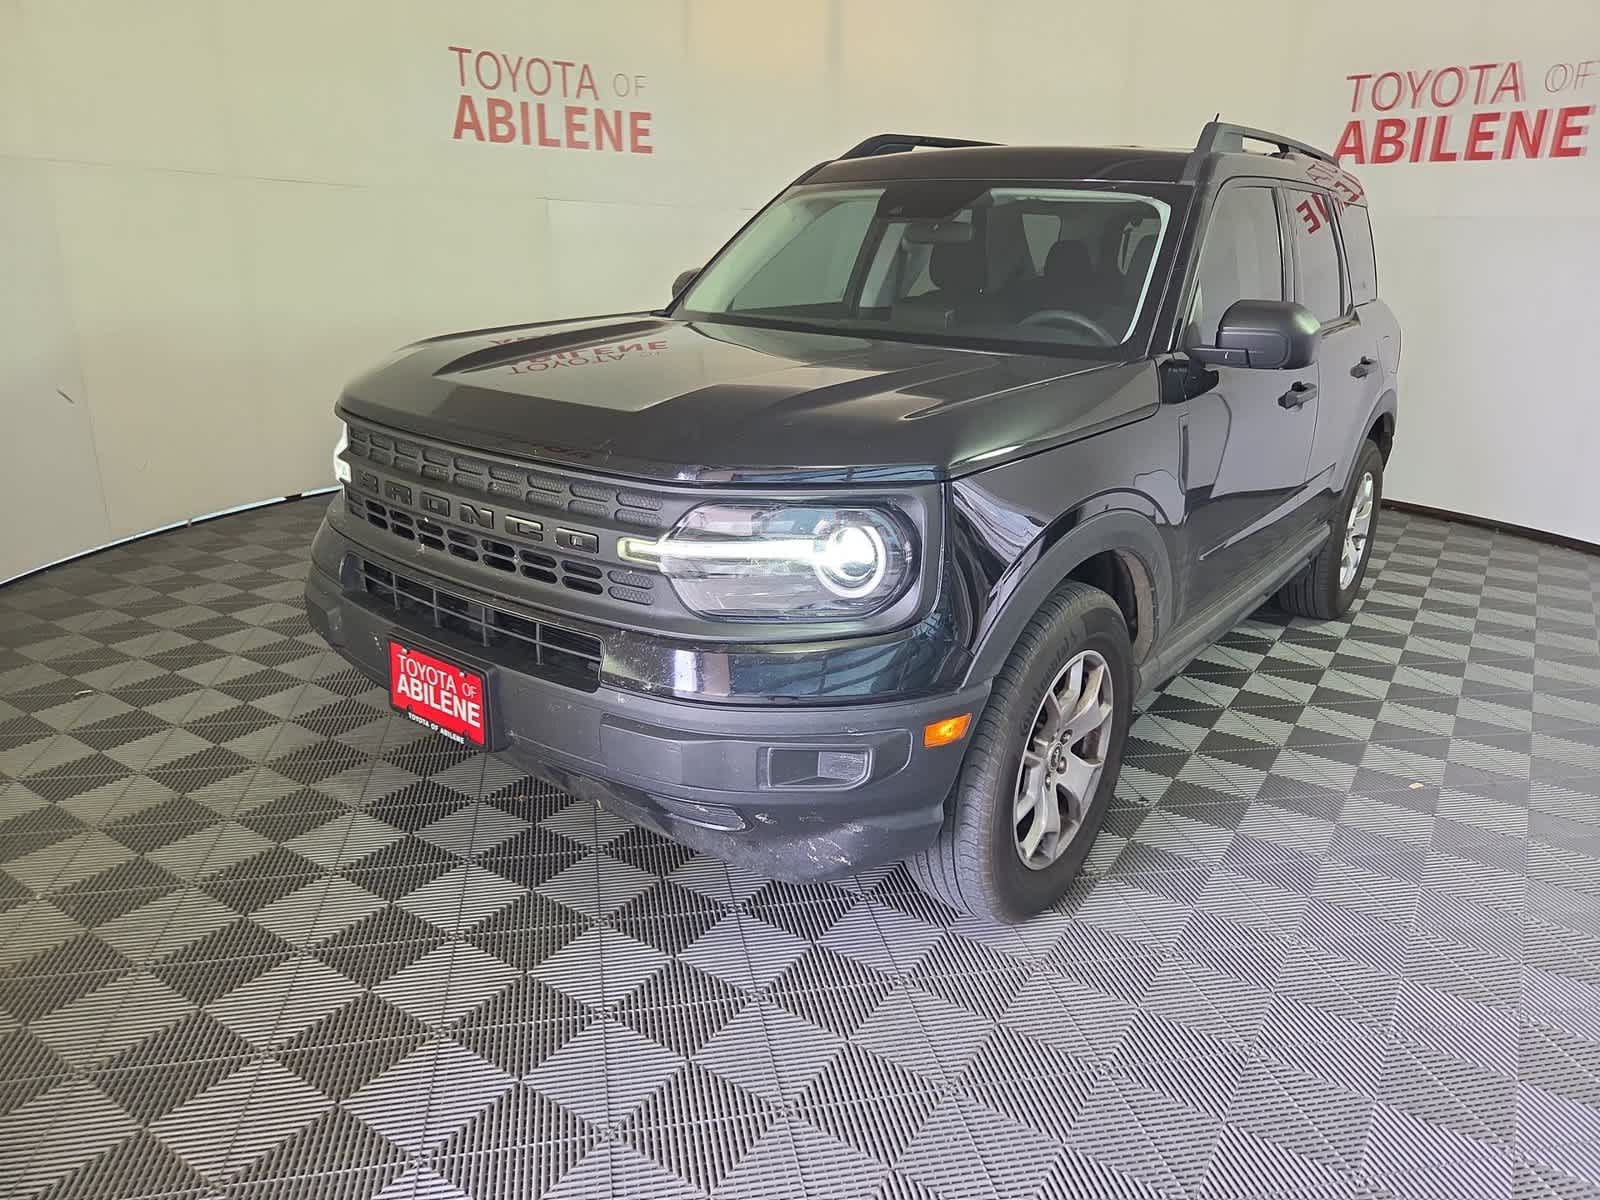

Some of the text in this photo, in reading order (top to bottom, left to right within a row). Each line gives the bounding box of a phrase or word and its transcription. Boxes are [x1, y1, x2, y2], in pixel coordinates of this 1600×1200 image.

[448, 46, 649, 101] TOYOTA OF
[1346, 60, 1600, 113] TOYOTA OF
[452, 94, 653, 154] ABILENE
[1333, 105, 1594, 165] ABILENE
[355, 469, 600, 554] BRONCO
[397, 654, 478, 698] TOYOTA OF
[397, 673, 481, 728] ABILENE
[408, 712, 464, 744] TOYOTA OF ABILENE
